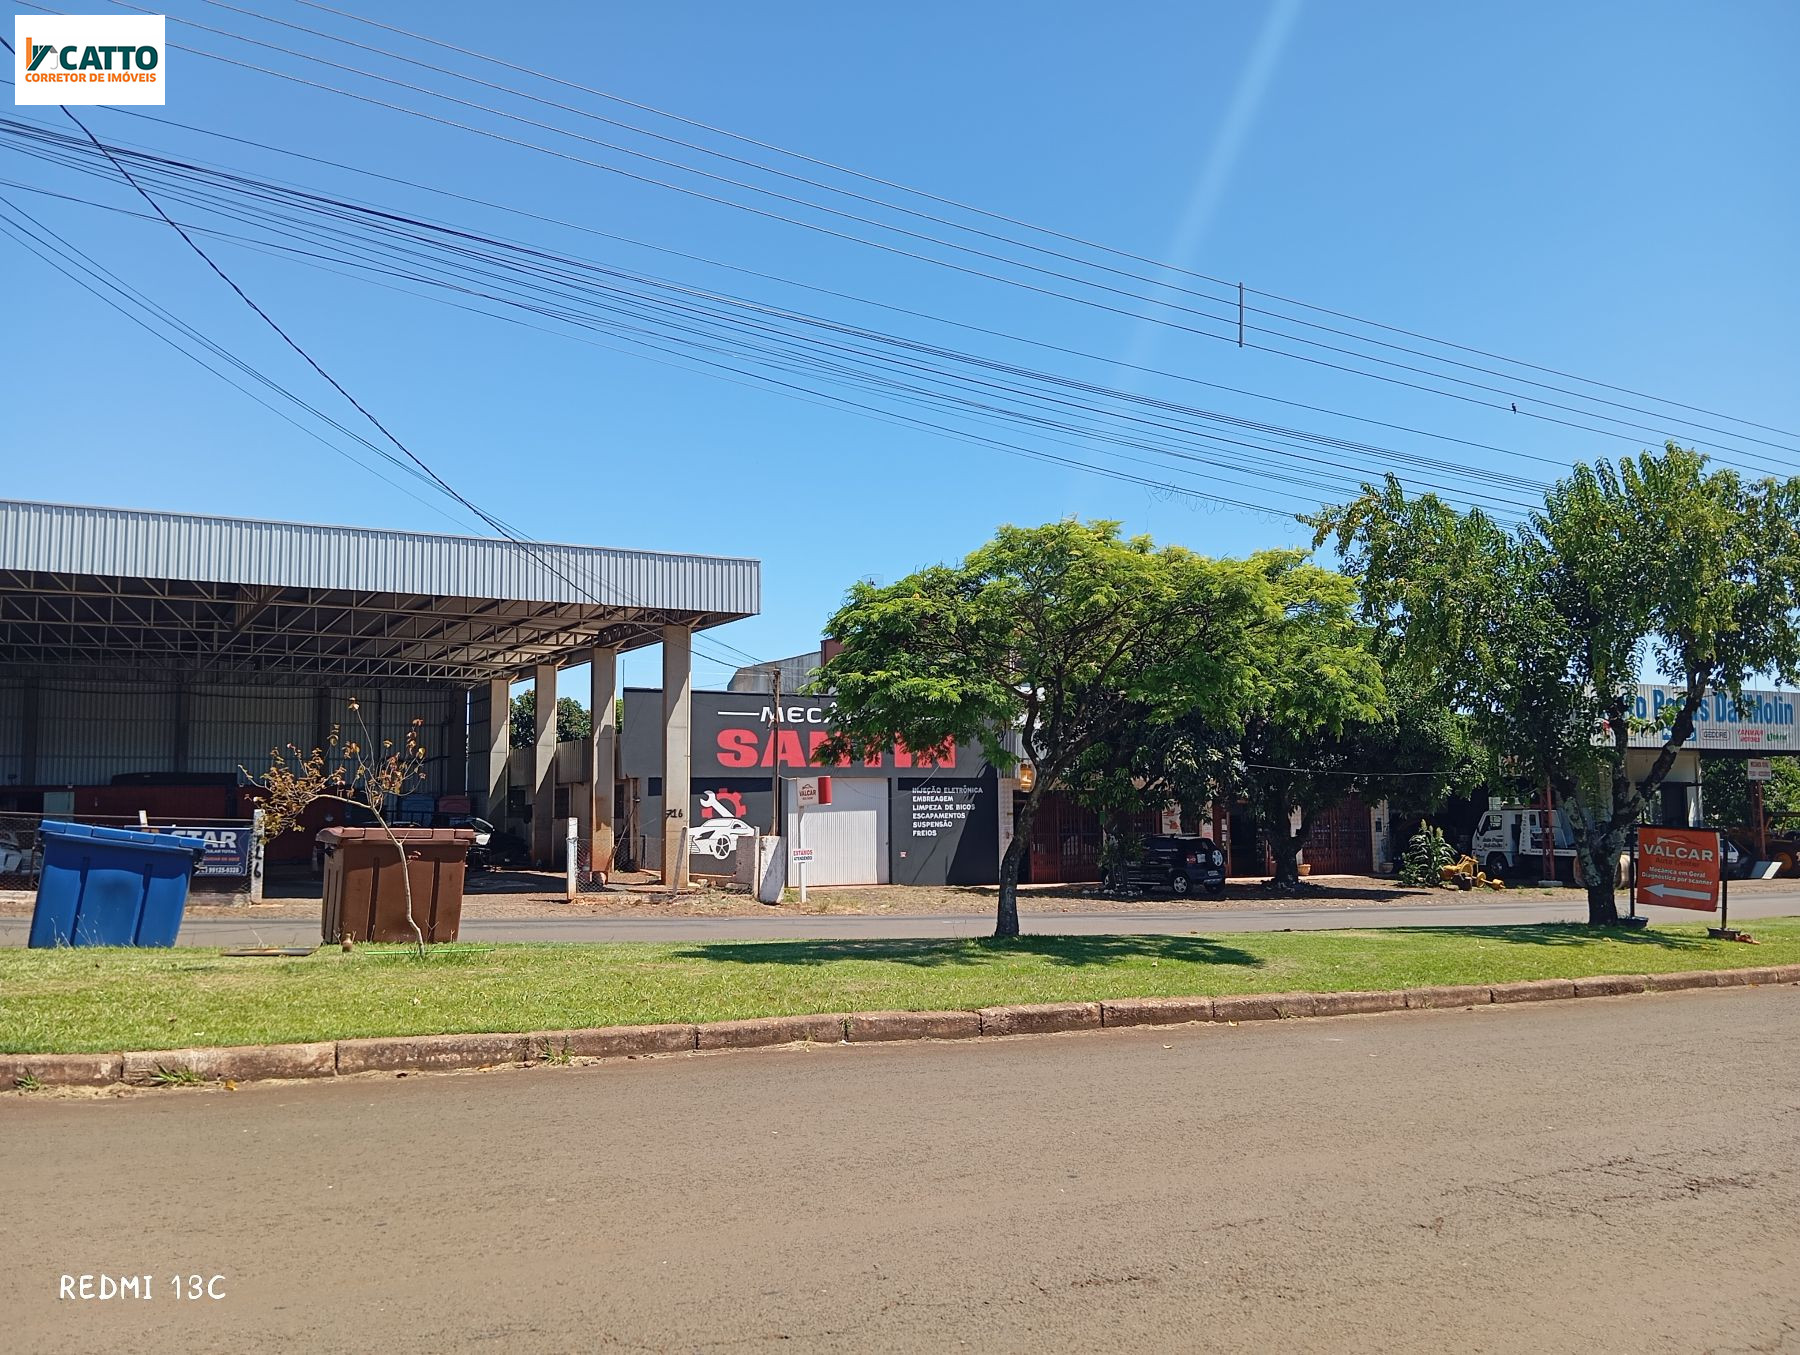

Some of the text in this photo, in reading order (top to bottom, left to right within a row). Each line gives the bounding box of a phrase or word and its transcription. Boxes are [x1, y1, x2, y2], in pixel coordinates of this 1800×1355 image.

[912, 785, 983, 795] INJEÇÃO ELETRÔNICA
[664, 808, 683, 820] 716
[912, 812, 966, 820] ESCAPAMENTOS
[912, 820, 953, 828] SUSPENSÃO
[1643, 844, 1713, 862] VALCAR
[1649, 866, 1677, 875] Mecânica
[1689, 870, 1706, 878] Geral
[1688, 878, 1713, 886] scanner
